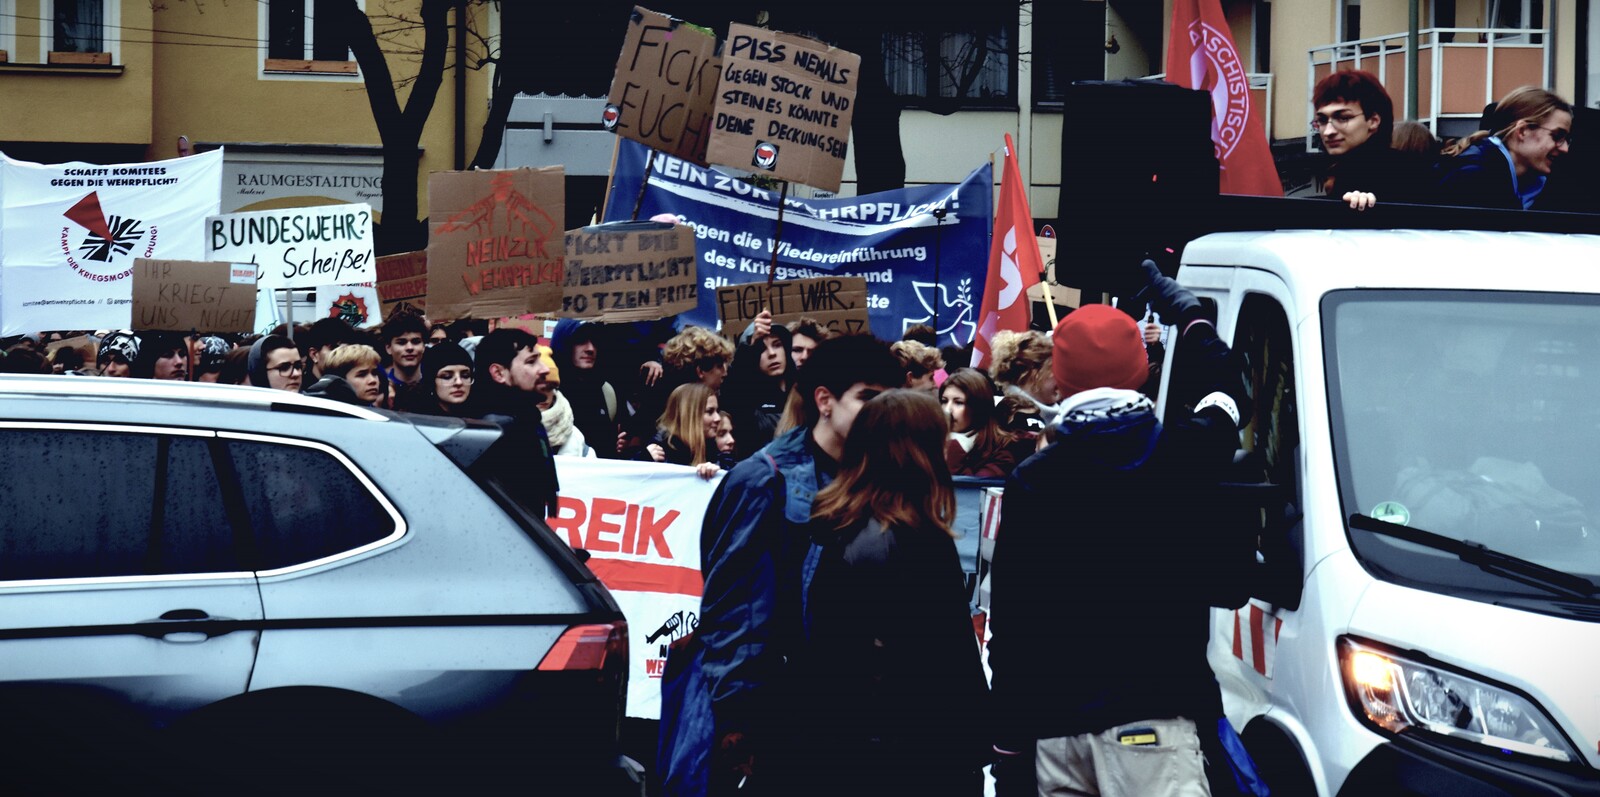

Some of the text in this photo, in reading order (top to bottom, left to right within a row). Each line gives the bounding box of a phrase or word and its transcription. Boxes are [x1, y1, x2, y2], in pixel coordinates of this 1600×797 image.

[731, 36, 851, 85] PISS NIEMALS
[725, 63, 850, 111] GEGEN STOCK UND
[716, 113, 755, 136] DEINE
[788, 103, 839, 128] KÖNNTE
[64, 167, 167, 176] SCHAFFT KOMITEES
[645, 149, 707, 186] NEIN
[50, 177, 179, 188] GEGEN DIE WEHRPFLICHT!
[237, 173, 383, 190] RAUMGESTALTUNG
[211, 211, 370, 251] BUNDESWEHR?
[60, 226, 71, 256] KAMPF
[66, 256, 80, 271] DER
[564, 232, 679, 256] FICKT DIE
[733, 232, 762, 250] die
[766, 238, 927, 264] Wiedereinführung
[144, 263, 172, 279] IHR
[282, 247, 373, 281] Scheiße!
[563, 256, 694, 287] WEHRPFLICHT
[704, 250, 736, 270] des
[158, 283, 231, 306] KRIEGT
[704, 276, 736, 290] all
[718, 283, 793, 323] FIGHT
[140, 309, 180, 327] UNS
[200, 308, 255, 328] NICHT
